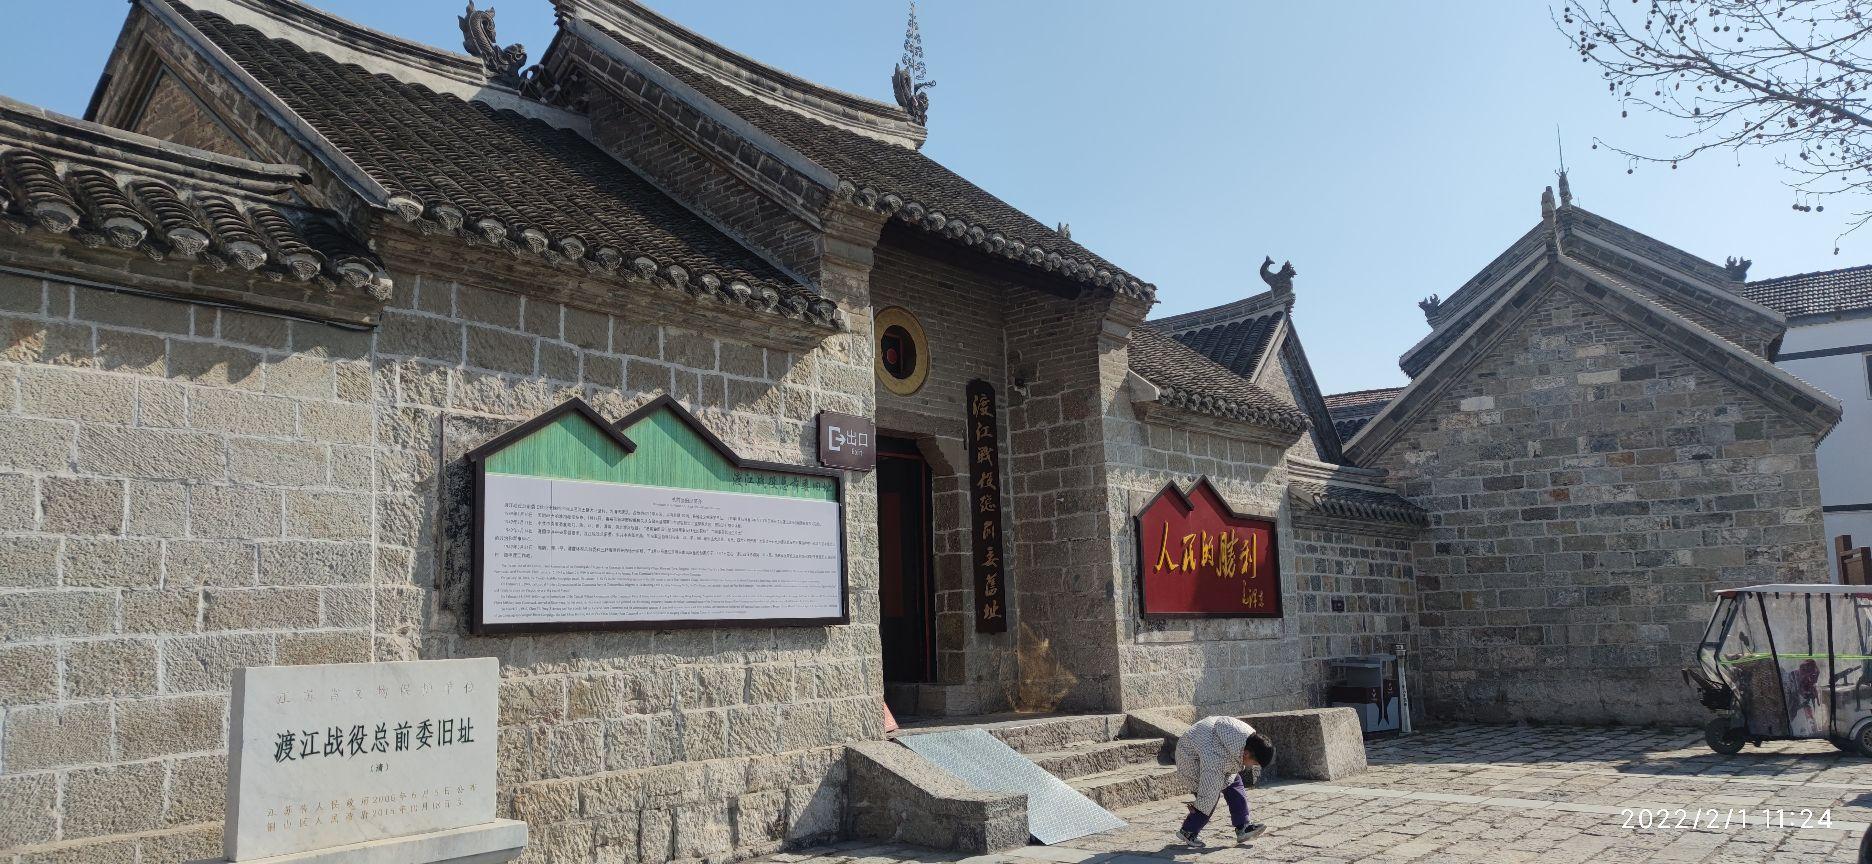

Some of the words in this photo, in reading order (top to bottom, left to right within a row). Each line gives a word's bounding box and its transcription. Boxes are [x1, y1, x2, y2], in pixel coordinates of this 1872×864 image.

[846, 428, 868, 447] 出口
[273, 717, 475, 763] 渡江战役总前委旧址
